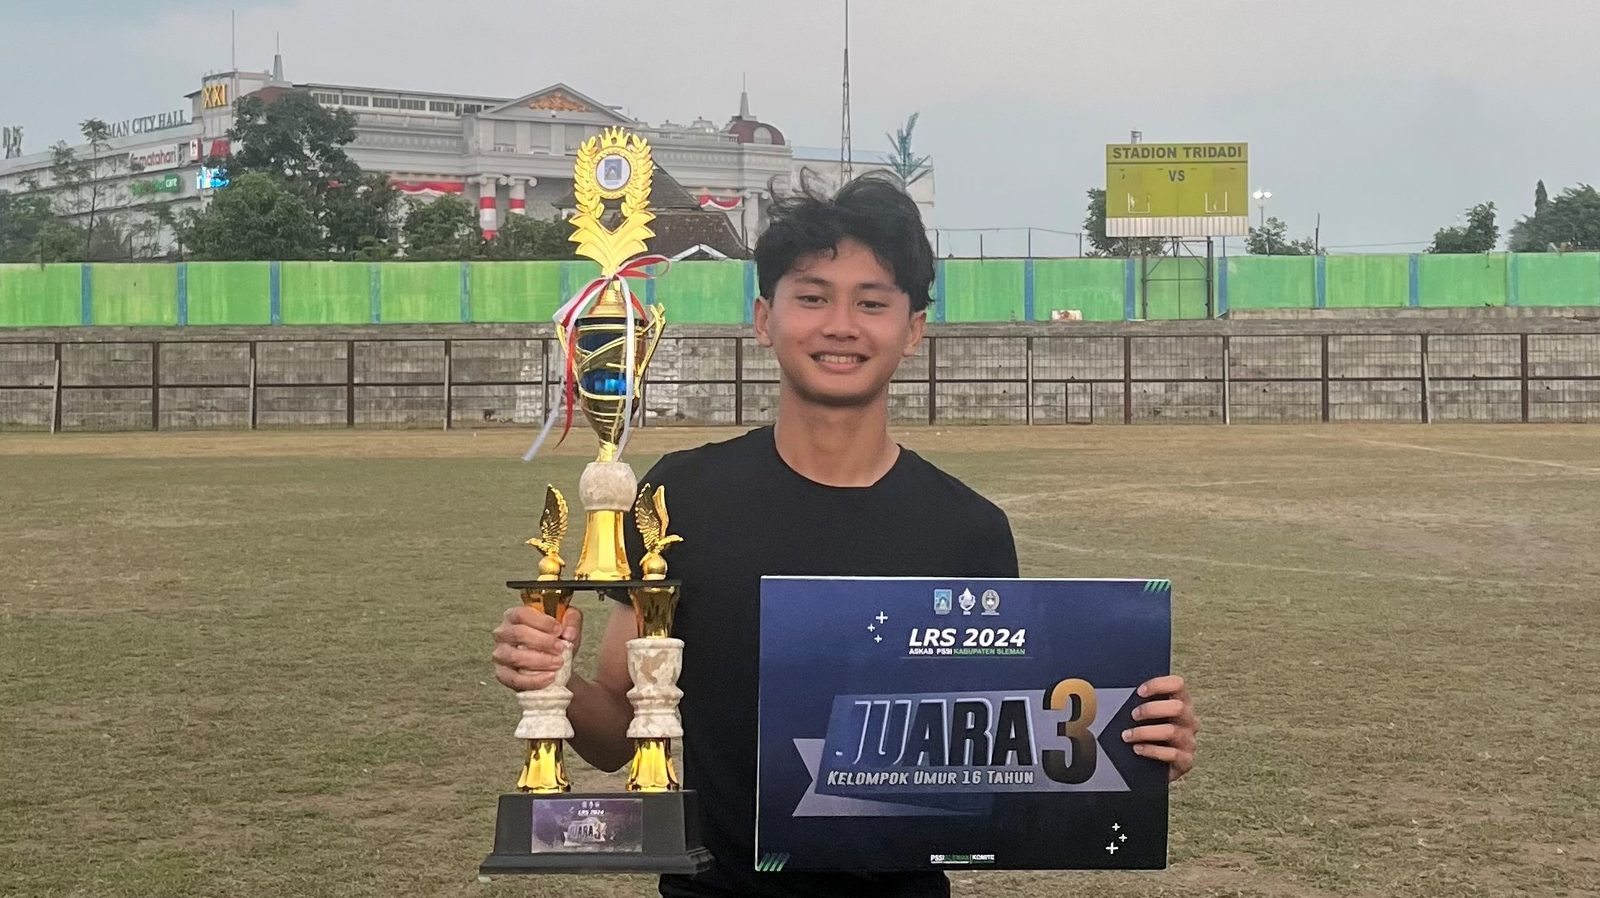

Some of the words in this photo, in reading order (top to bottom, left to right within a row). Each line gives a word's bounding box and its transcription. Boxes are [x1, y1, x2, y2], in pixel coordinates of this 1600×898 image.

[204, 84, 228, 108] XXI
[132, 114, 156, 134] CITY
[158, 109, 185, 129] HALL
[139, 145, 176, 166] matahari
[1112, 147, 1177, 159] STADION
[1183, 146, 1242, 158] TRIDADI
[1168, 170, 1185, 182] VS
[909, 628, 957, 647] LRS
[962, 628, 1026, 647] 2024
[834, 696, 1038, 766] JUARA
[1041, 677, 1098, 785] 3
[826, 770, 909, 786] KELOMPOK
[913, 770, 957, 786] UMUR
[962, 770, 982, 785] 16
[986, 770, 1035, 785] TAHUN
